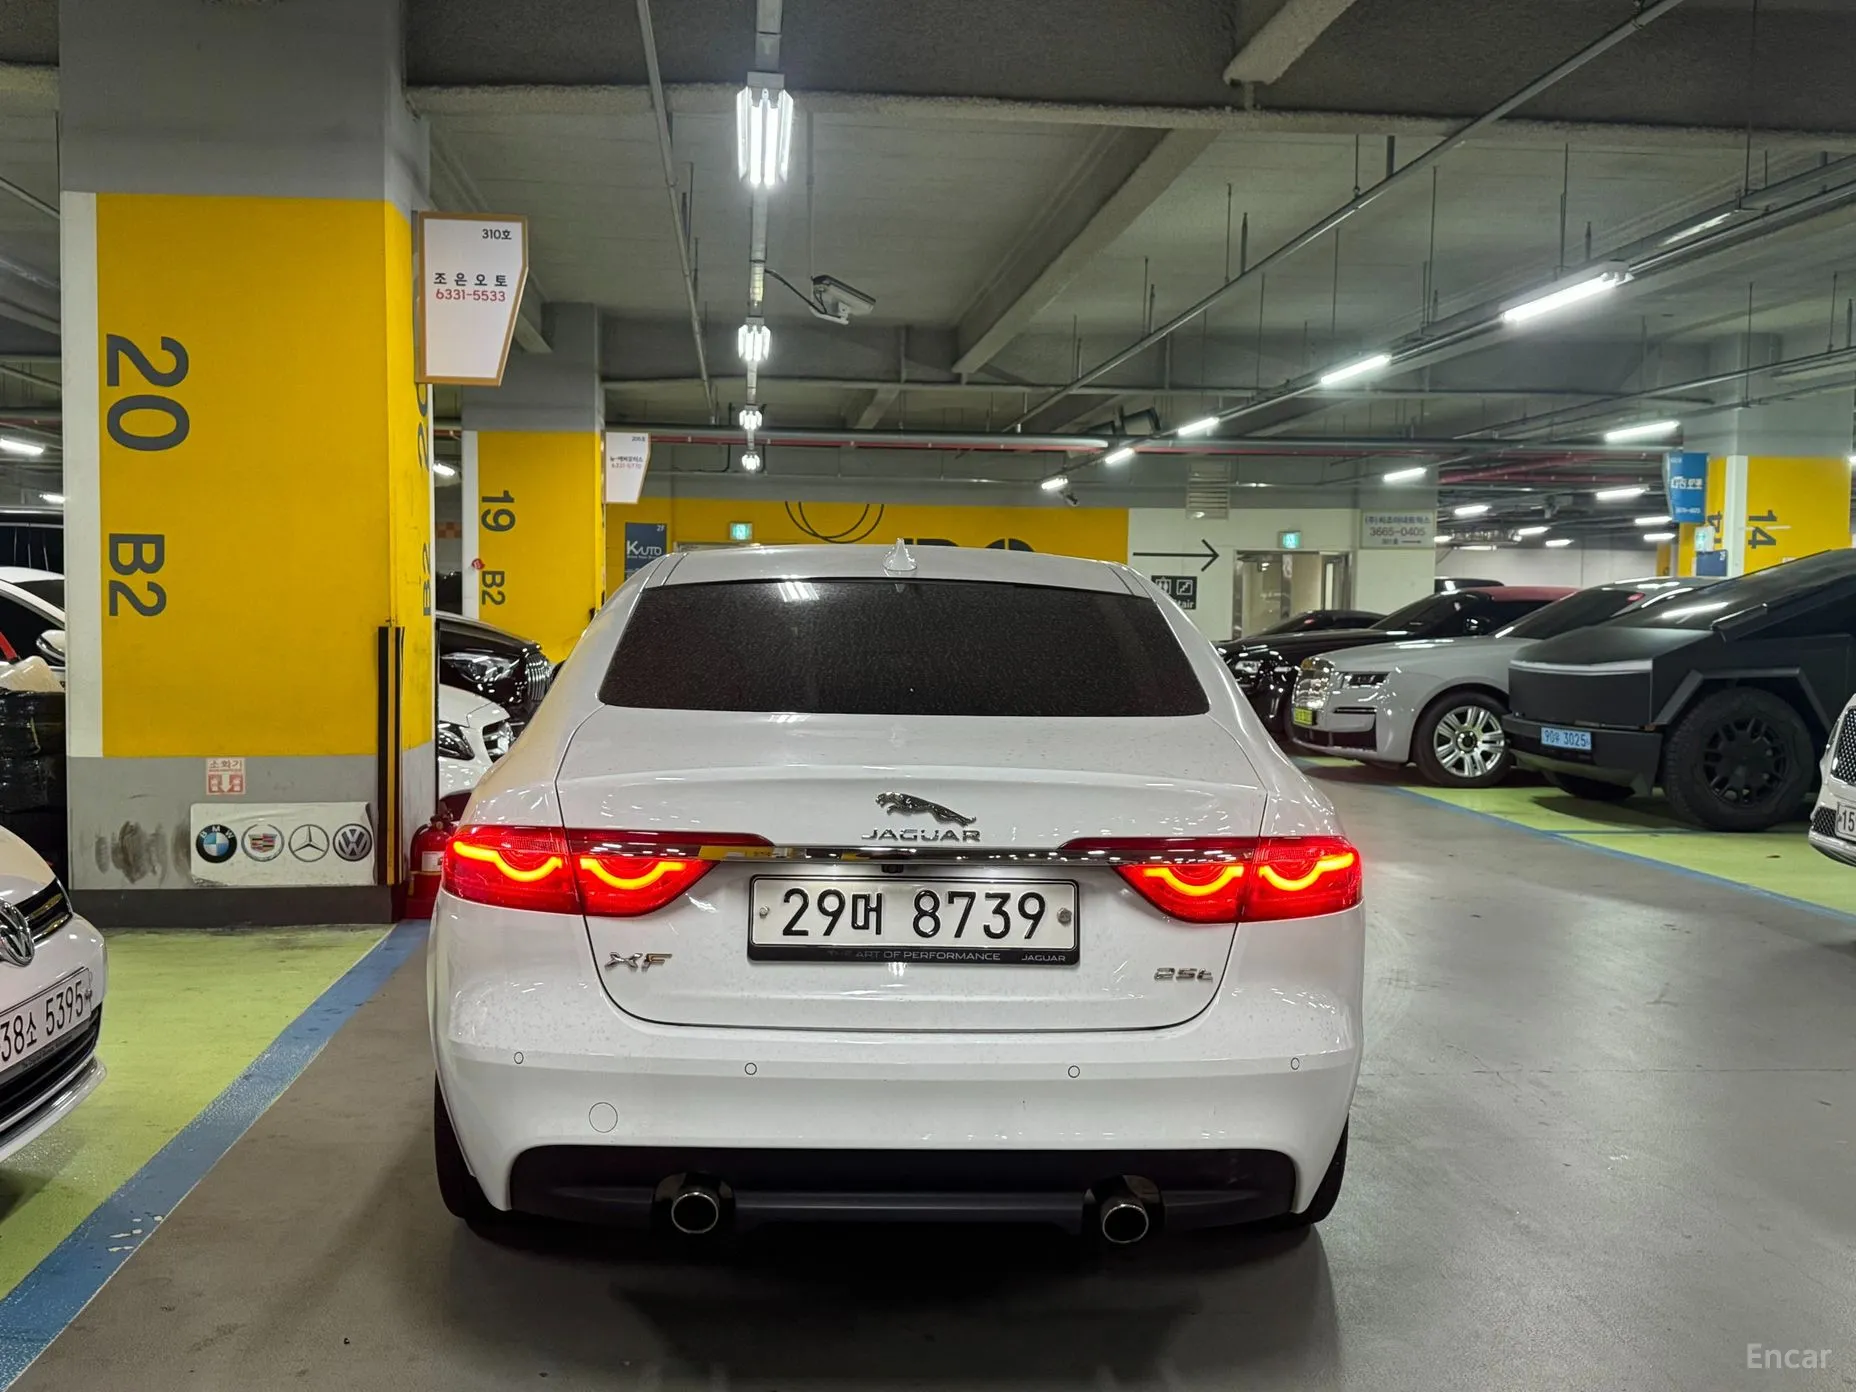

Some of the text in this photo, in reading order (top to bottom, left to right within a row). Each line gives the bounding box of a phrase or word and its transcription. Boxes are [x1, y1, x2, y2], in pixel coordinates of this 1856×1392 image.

[481, 228, 512, 240] 310호
[435, 288, 506, 302] 6331-5533
[106, 333, 190, 617] 20 B2
[1747, 509, 1777, 549] 14
[481, 490, 516, 606] 19 B2
[1563, 732, 1587, 747] 3025
[861, 828, 982, 842] JAGUAR
[782, 888, 1047, 939] 29머 8739
[604, 952, 673, 972] XF
[855, 951, 881, 960] ART
[883, 951, 900, 960] OF
[903, 952, 1001, 961] PERFORMANCE
[1021, 954, 1066, 962] JAGUAR
[0, 1011, 38, 1063] 38소
[45, 980, 84, 1037] 5395
